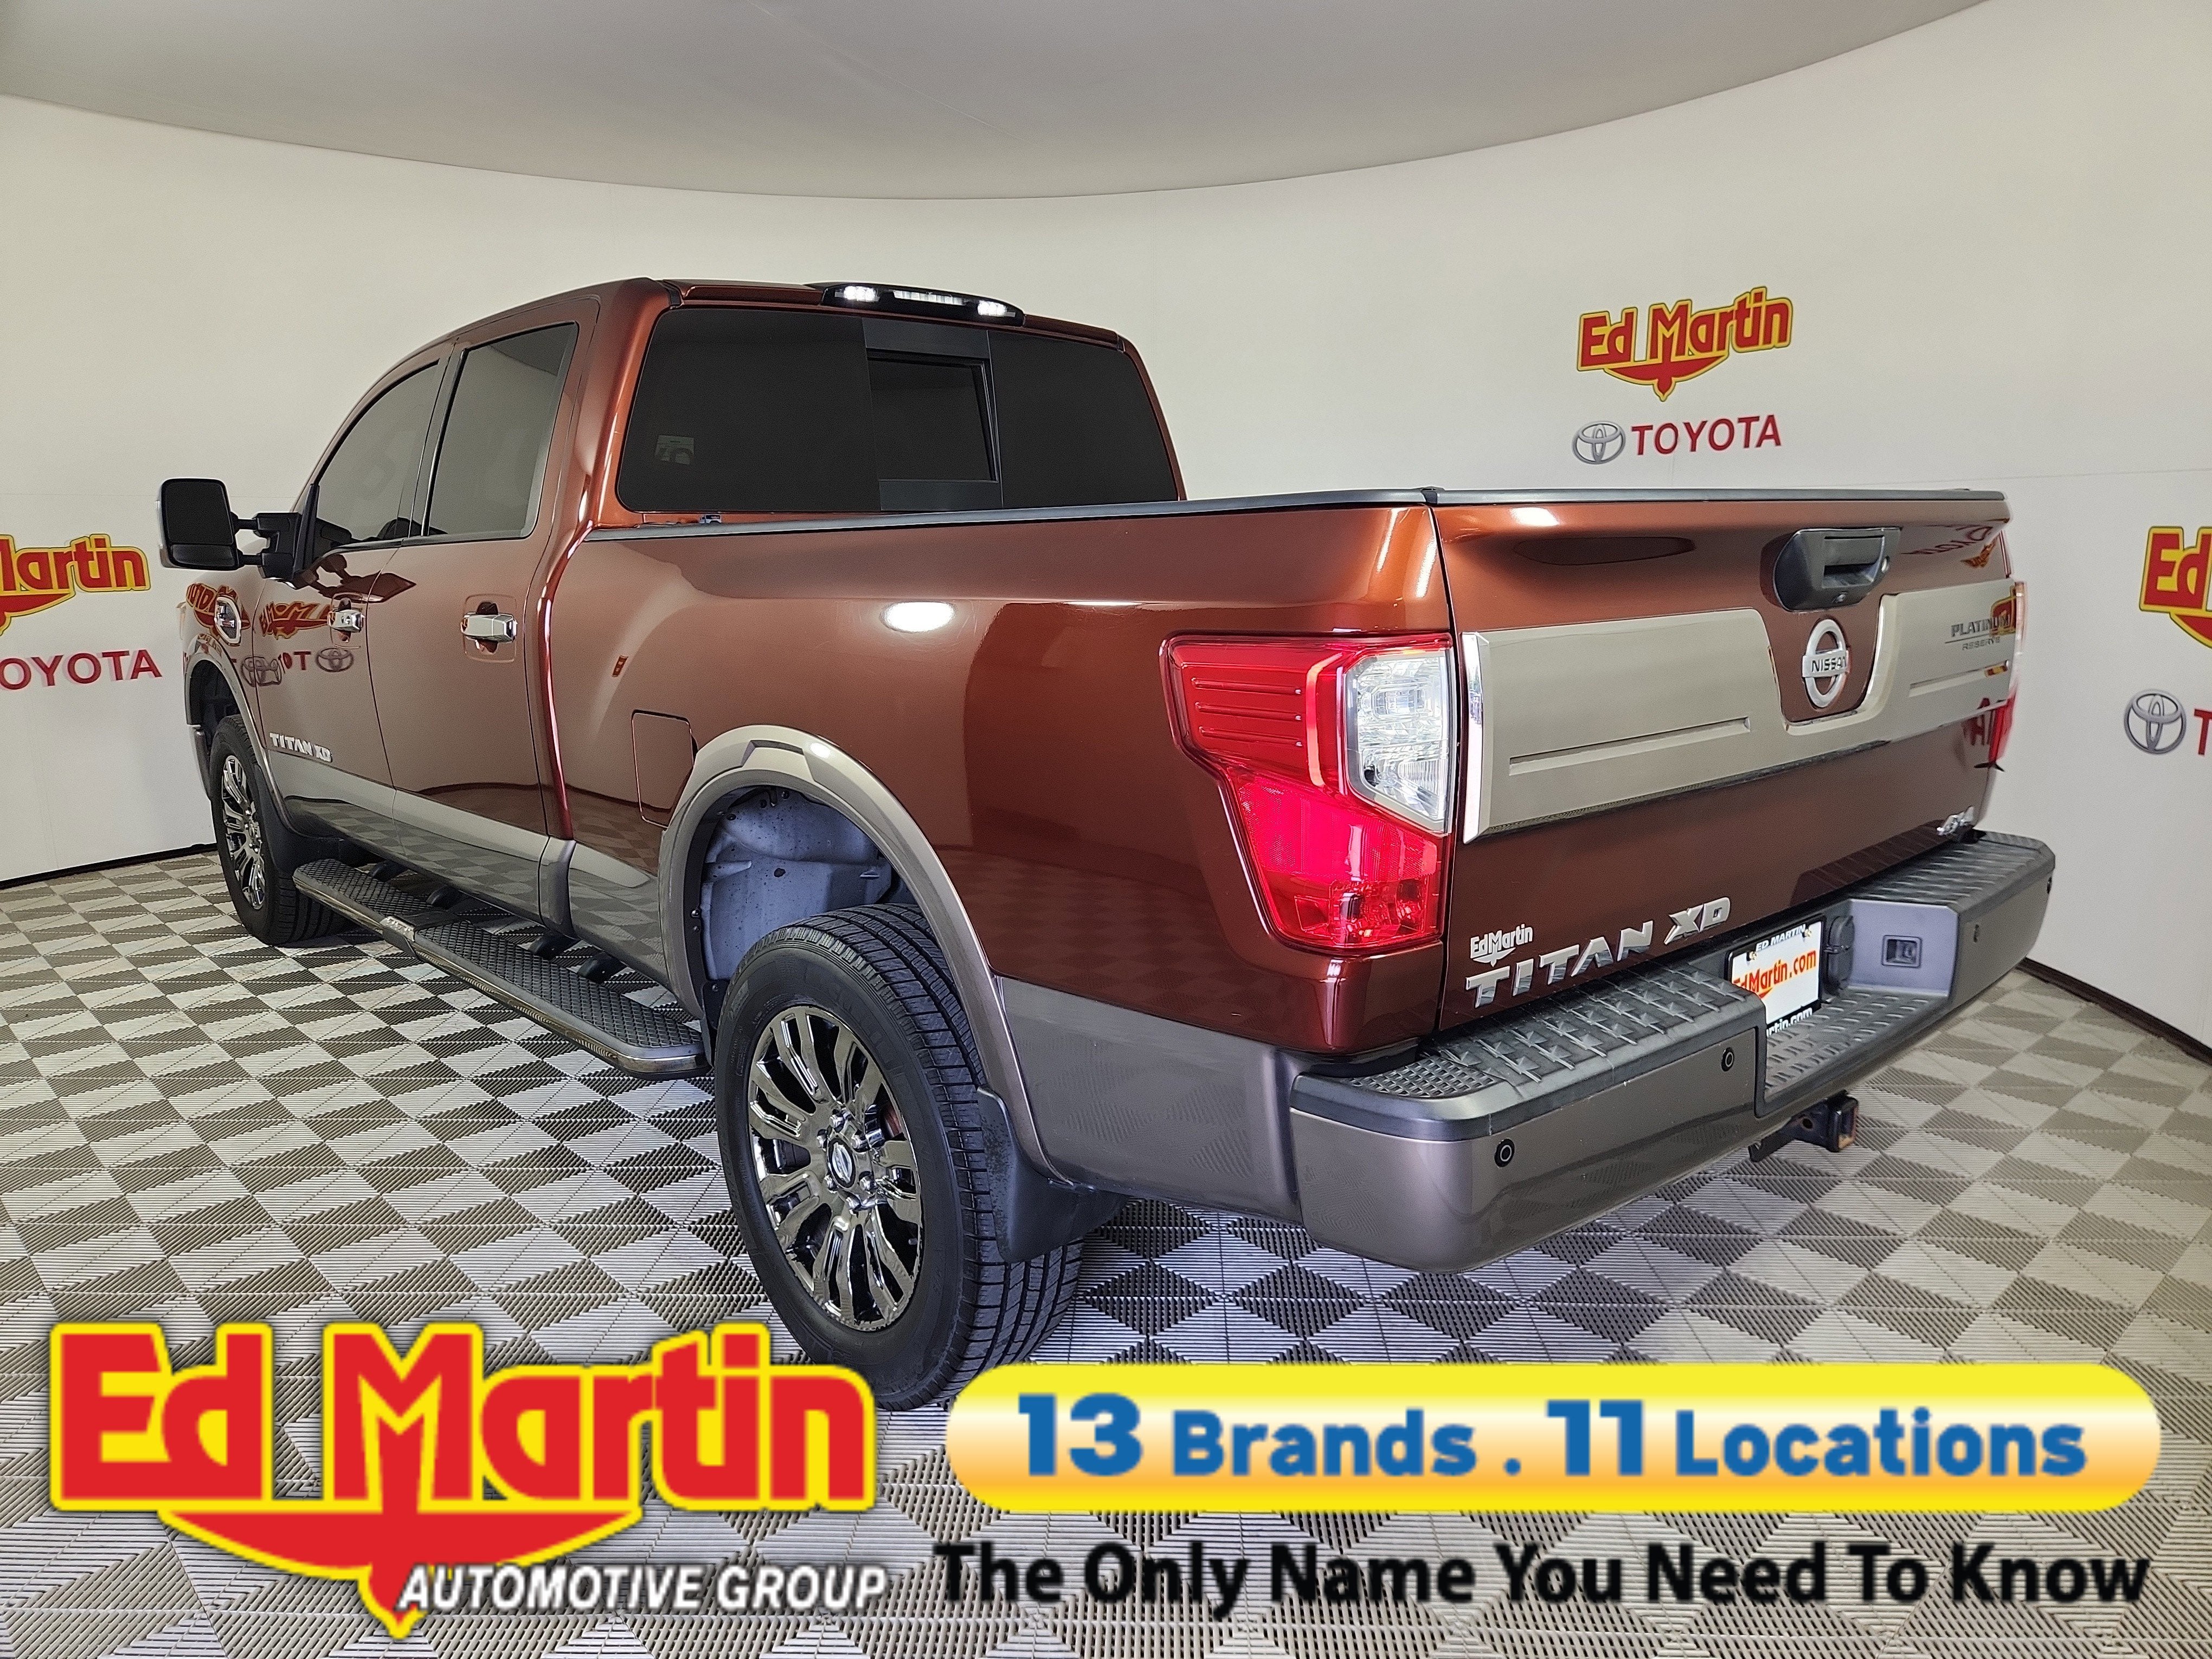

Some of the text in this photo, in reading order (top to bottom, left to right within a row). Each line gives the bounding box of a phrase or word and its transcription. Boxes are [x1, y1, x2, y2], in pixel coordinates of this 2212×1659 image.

[1577, 286, 1793, 371] Ed Martin
[1631, 414, 1782, 456] TOYOTA
[2139, 526, 2212, 613] Ed
[269, 732, 314, 756] TITAN
[1465, 897, 1731, 1008] TITAN XD
[1756, 923, 1806, 952] ED MARTIN
